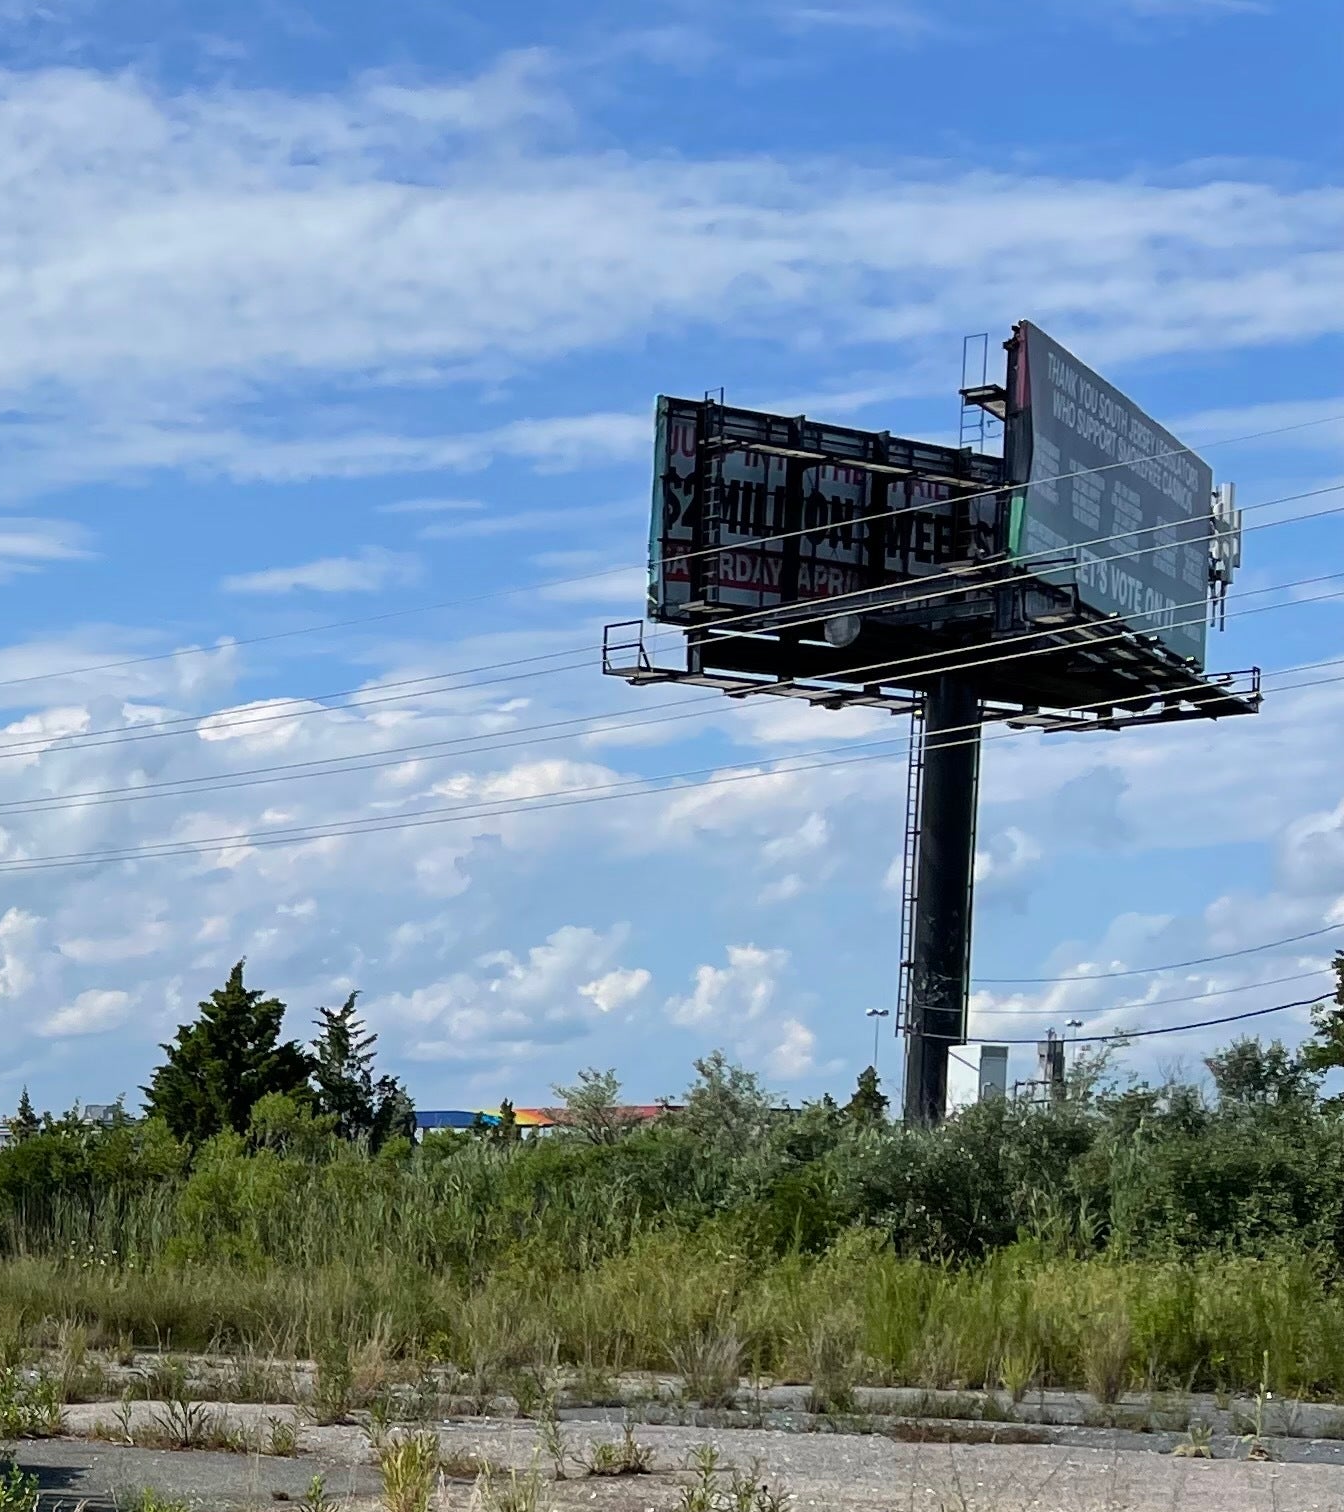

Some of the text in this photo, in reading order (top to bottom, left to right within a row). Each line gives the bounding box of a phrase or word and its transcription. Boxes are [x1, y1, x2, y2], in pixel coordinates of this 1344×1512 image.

[1047, 352, 1079, 399] THANK
[1078, 377, 1099, 413] YOU
[1099, 393, 1129, 437] SOUTH
[1053, 390, 1076, 428] WHO
[1077, 409, 1117, 457] SUPPORT
[1073, 543, 1108, 595] LET'S
[1110, 564, 1144, 615] VOTE
[1145, 587, 1163, 627] ON
[1164, 597, 1177, 633] IT
